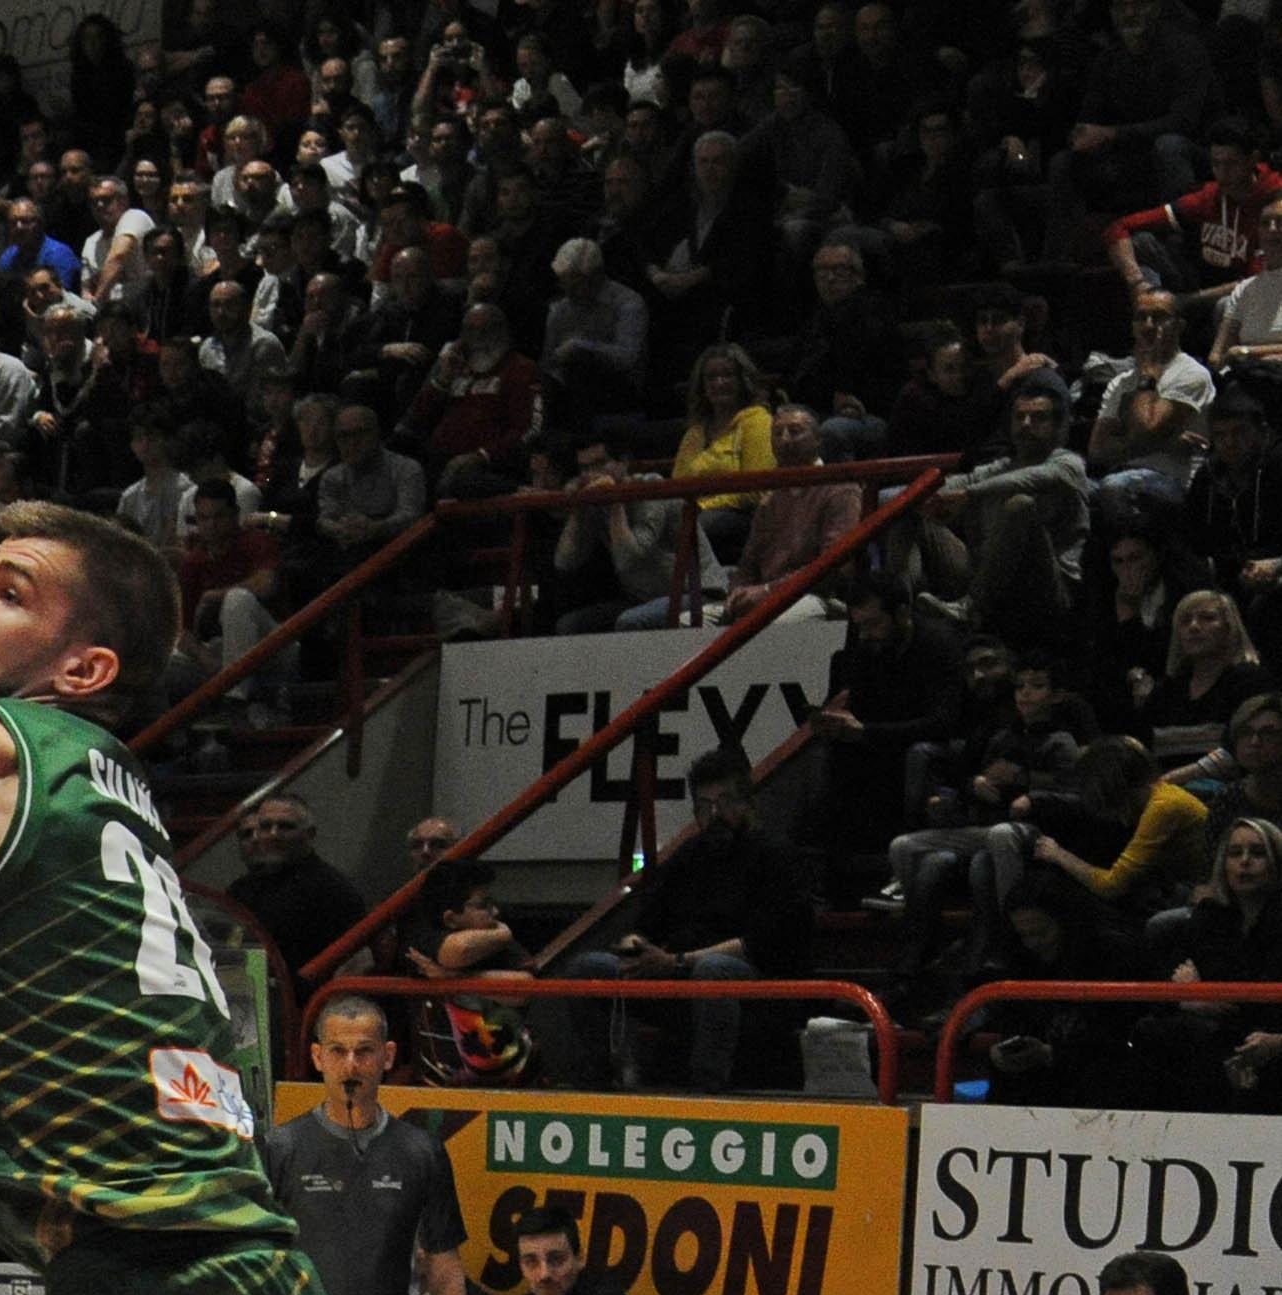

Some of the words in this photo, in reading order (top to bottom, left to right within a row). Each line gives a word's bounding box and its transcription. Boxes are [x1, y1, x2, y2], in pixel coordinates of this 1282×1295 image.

[459, 699, 531, 747] The
[494, 1119, 829, 1179] NOLEGGIO
[932, 1146, 1282, 1257] STUDI
